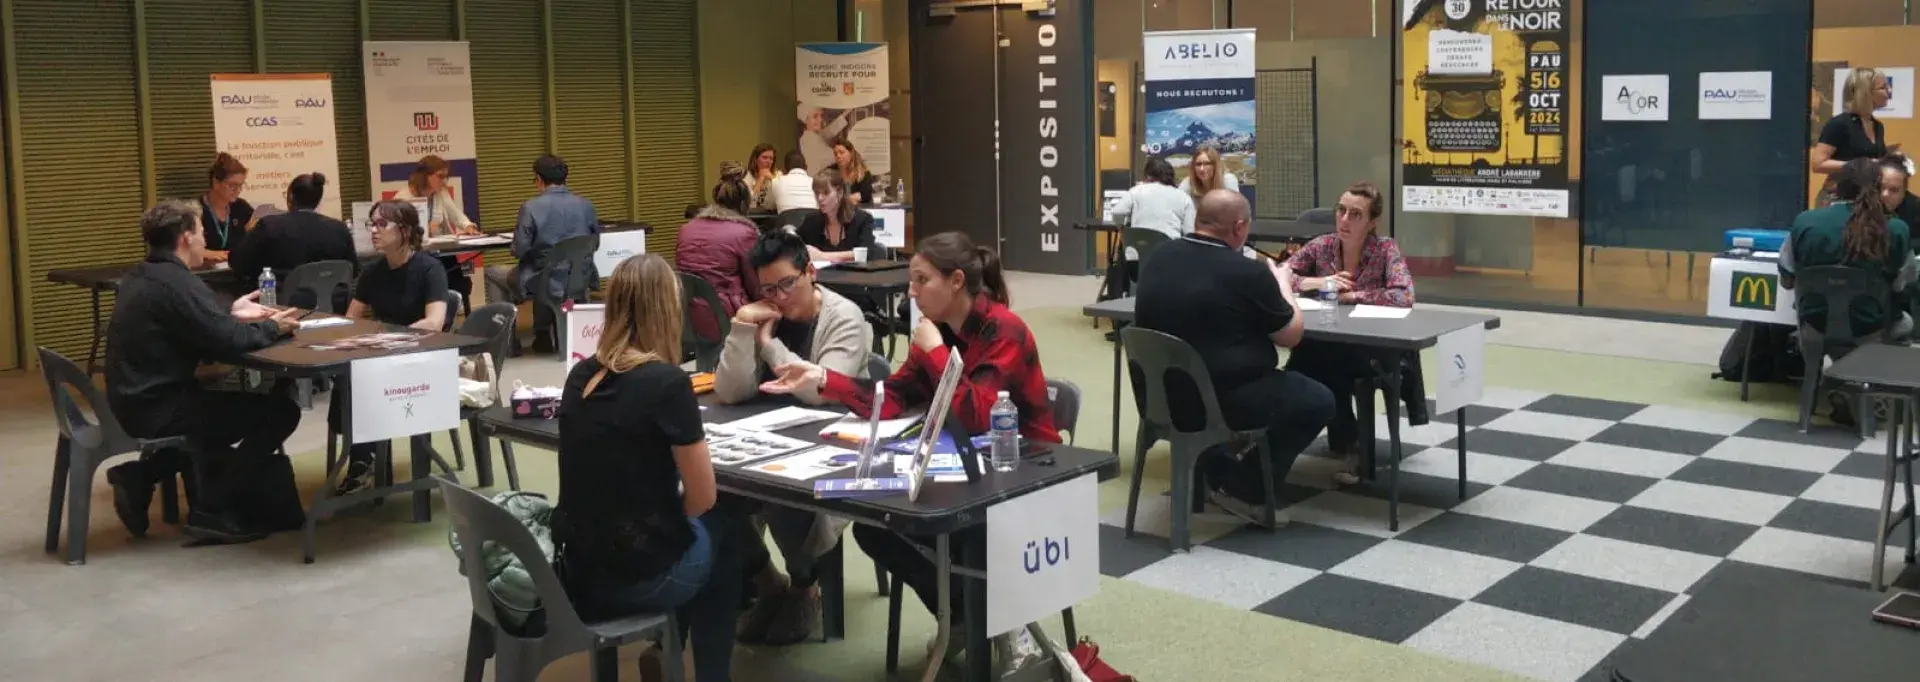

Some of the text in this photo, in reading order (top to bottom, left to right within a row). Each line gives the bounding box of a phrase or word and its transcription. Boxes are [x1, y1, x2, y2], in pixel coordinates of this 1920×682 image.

[1510, 12, 1561, 30] NOIR
[1165, 42, 1238, 60] ABELIO
[1531, 54, 1561, 67] PAU
[808, 71, 849, 79] RECRUTE
[851, 71, 877, 79] POUR
[1156, 90, 1181, 98] NOUS
[1183, 89, 1237, 97] RECRUTONS
[1704, 88, 1737, 98] PAU
[220, 94, 252, 105] PAU
[295, 97, 326, 108] PAU
[1530, 93, 1561, 108] OCT
[245, 116, 278, 127] CCAS
[1530, 112, 1561, 124] 2024
[436, 134, 450, 143] DE
[406, 144, 450, 155] L'EMPLOI
